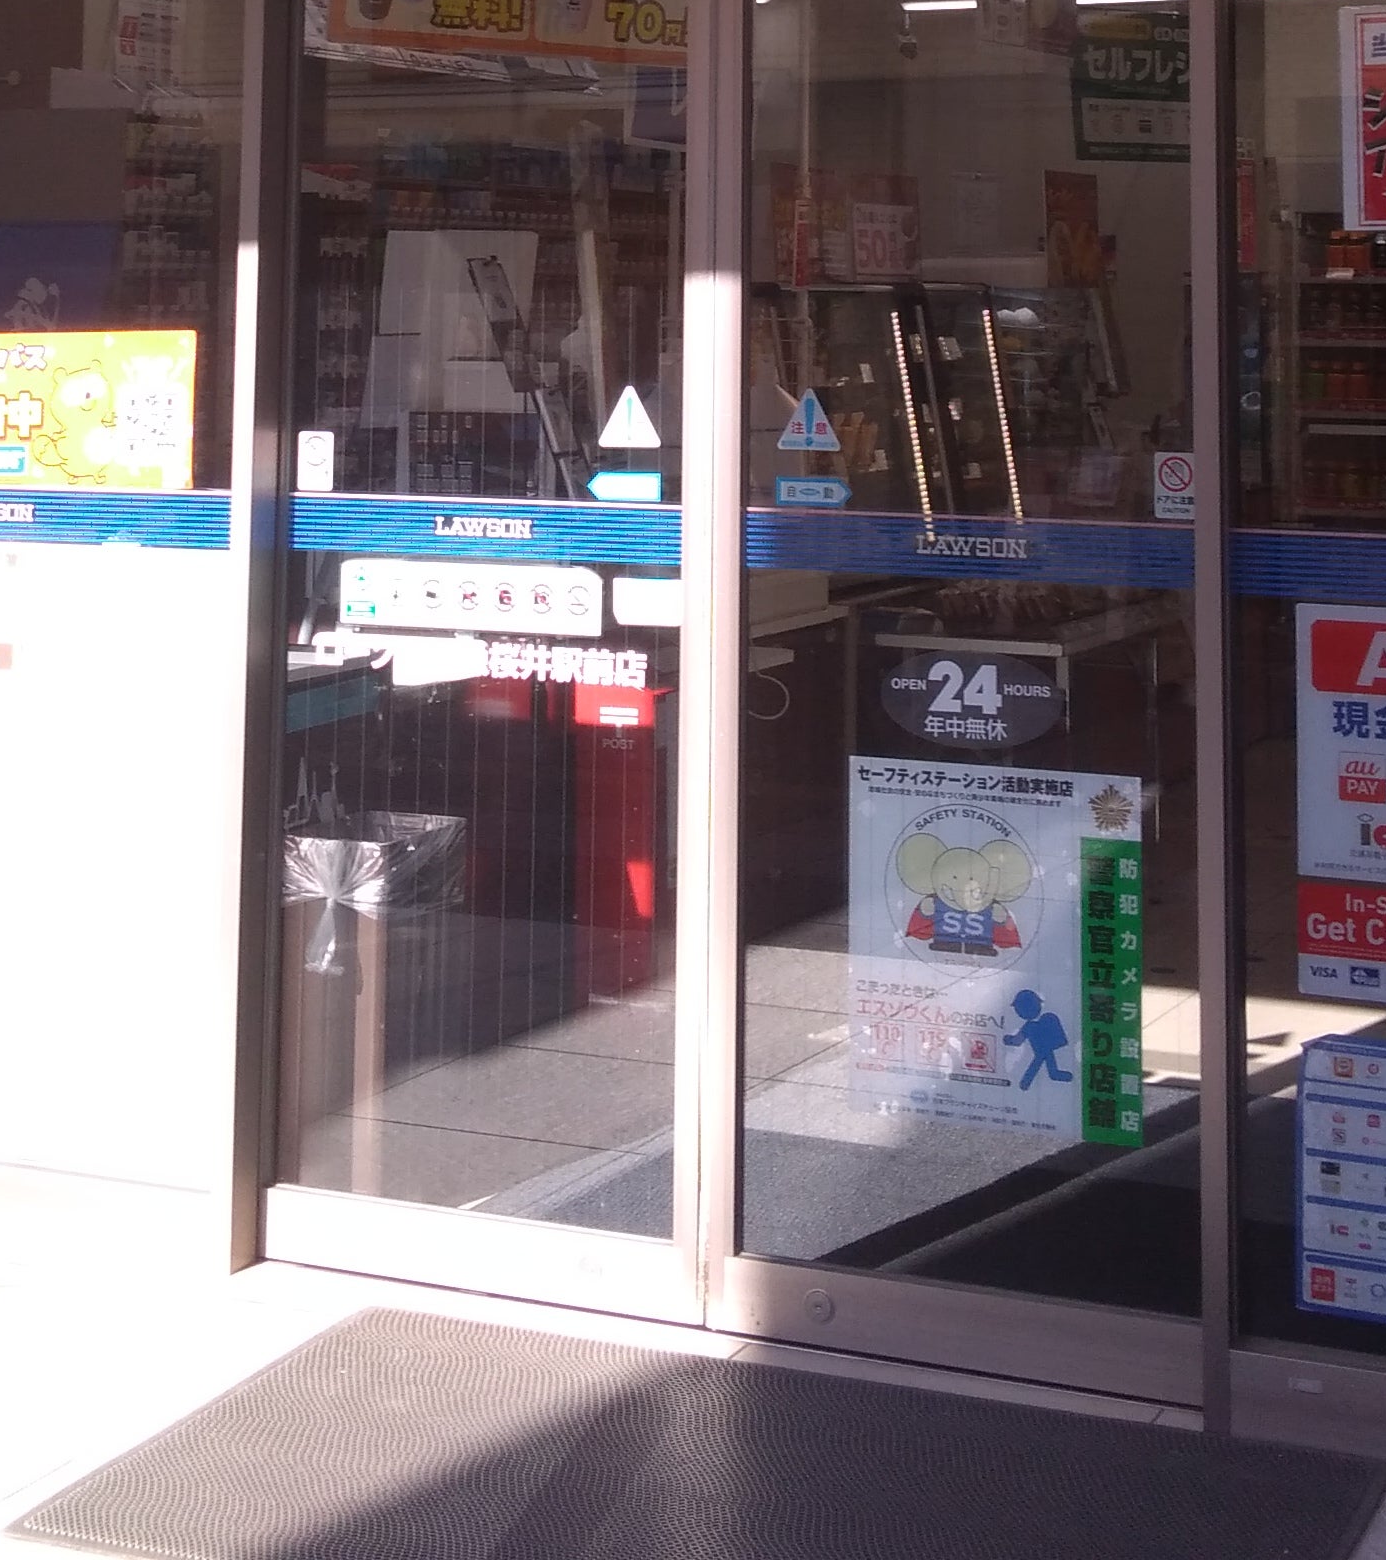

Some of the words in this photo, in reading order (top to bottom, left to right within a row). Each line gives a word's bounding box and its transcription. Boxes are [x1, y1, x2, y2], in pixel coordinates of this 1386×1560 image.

[434, 516, 533, 539] LAWSON
[916, 535, 1027, 559] LAWSON
[891, 677, 927, 691] OPEN
[927, 660, 1003, 715] 24
[1003, 684, 1052, 698] HOURS
[924, 715, 1008, 741] 年中無休
[1344, 759, 1380, 776] au
[858, 765, 1075, 798] セーフティステーション活動実施店
[1346, 780, 1380, 796] PAY
[915, 809, 958, 831] SAFETY
[962, 808, 1012, 838] STATION
[1306, 912, 1356, 943] Get
[1309, 965, 1338, 980] VISA
[1118, 857, 1140, 1133] 防犯カメラ設置店
